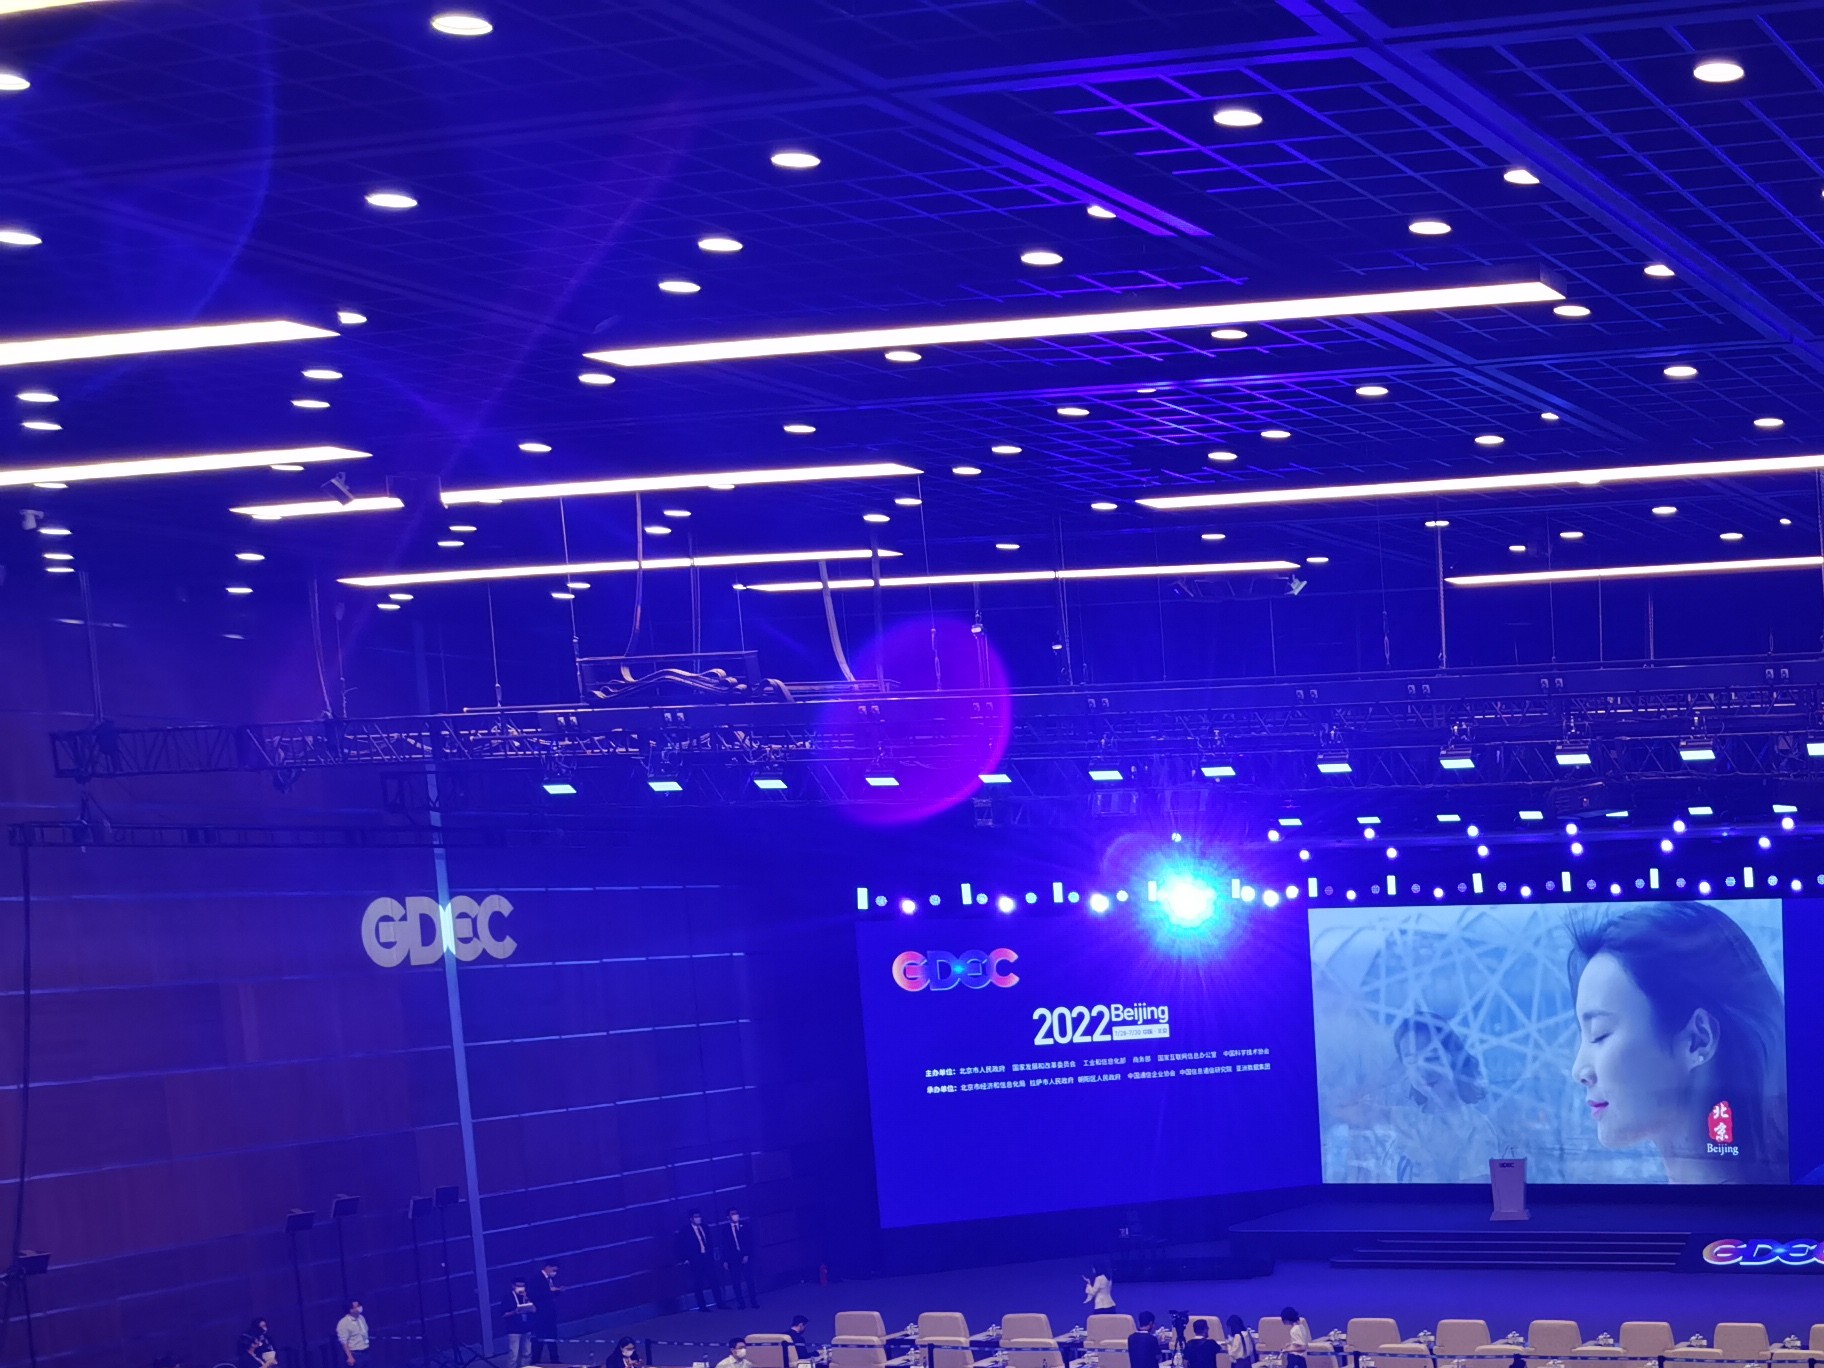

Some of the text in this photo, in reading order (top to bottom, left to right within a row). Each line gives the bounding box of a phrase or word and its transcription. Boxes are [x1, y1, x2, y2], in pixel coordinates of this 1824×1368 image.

[361, 895, 517, 968] GDEC
[892, 947, 1020, 992] GDEC
[1032, 1003, 1169, 1046] 2022 Beijing
[1712, 1102, 1729, 1142] 北京
[1706, 1143, 1739, 1156] Beijing
